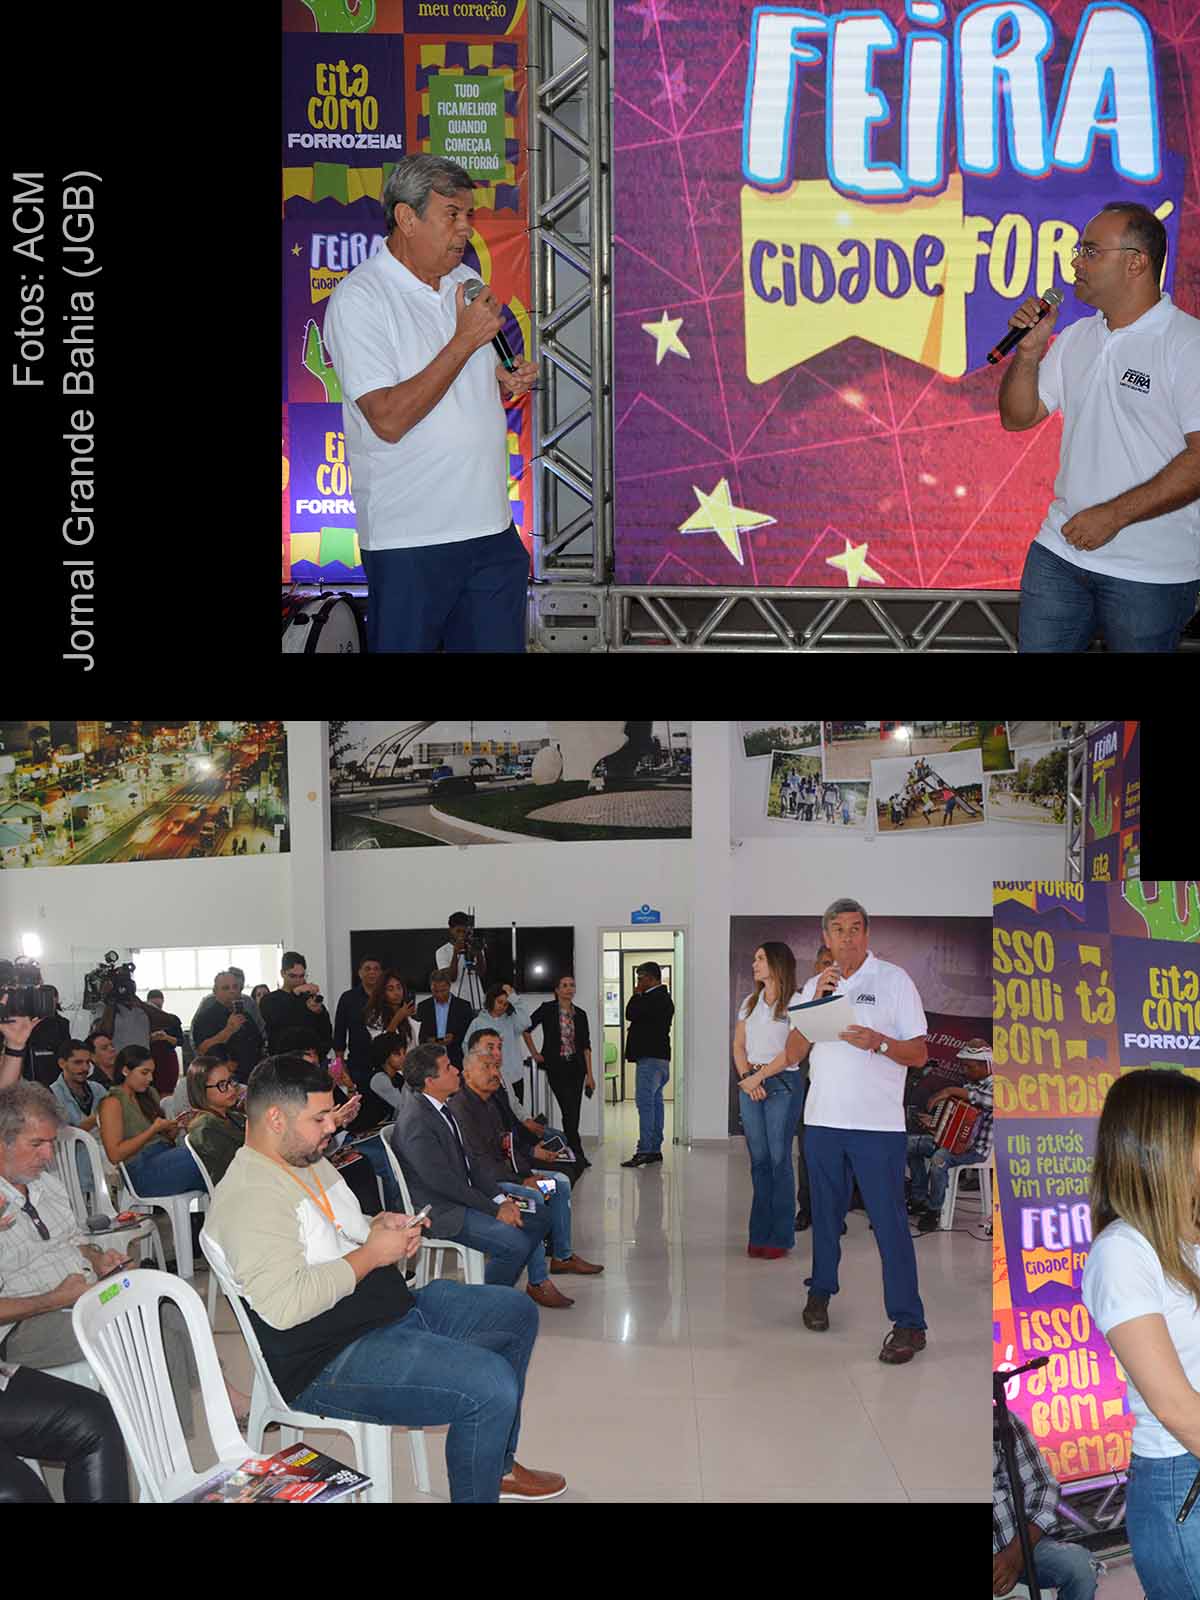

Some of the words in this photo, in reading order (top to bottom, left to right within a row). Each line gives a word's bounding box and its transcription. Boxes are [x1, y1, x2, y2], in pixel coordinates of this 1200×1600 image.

[418, 3, 450, 17] meu
[453, 2, 507, 21] coração
[454, 83, 480, 98] TUDO
[307, 96, 379, 133] COMO
[437, 101, 458, 116] FICA
[458, 101, 497, 116] MELHOR
[448, 120, 488, 134] QUANDO
[287, 133, 403, 149] FORROZEIA!
[445, 138, 480, 154] COMEÇA
[480, 139, 492, 152] A
[468, 153, 499, 169] FORRÓ
[1121, 371, 1151, 390] FEIRA
